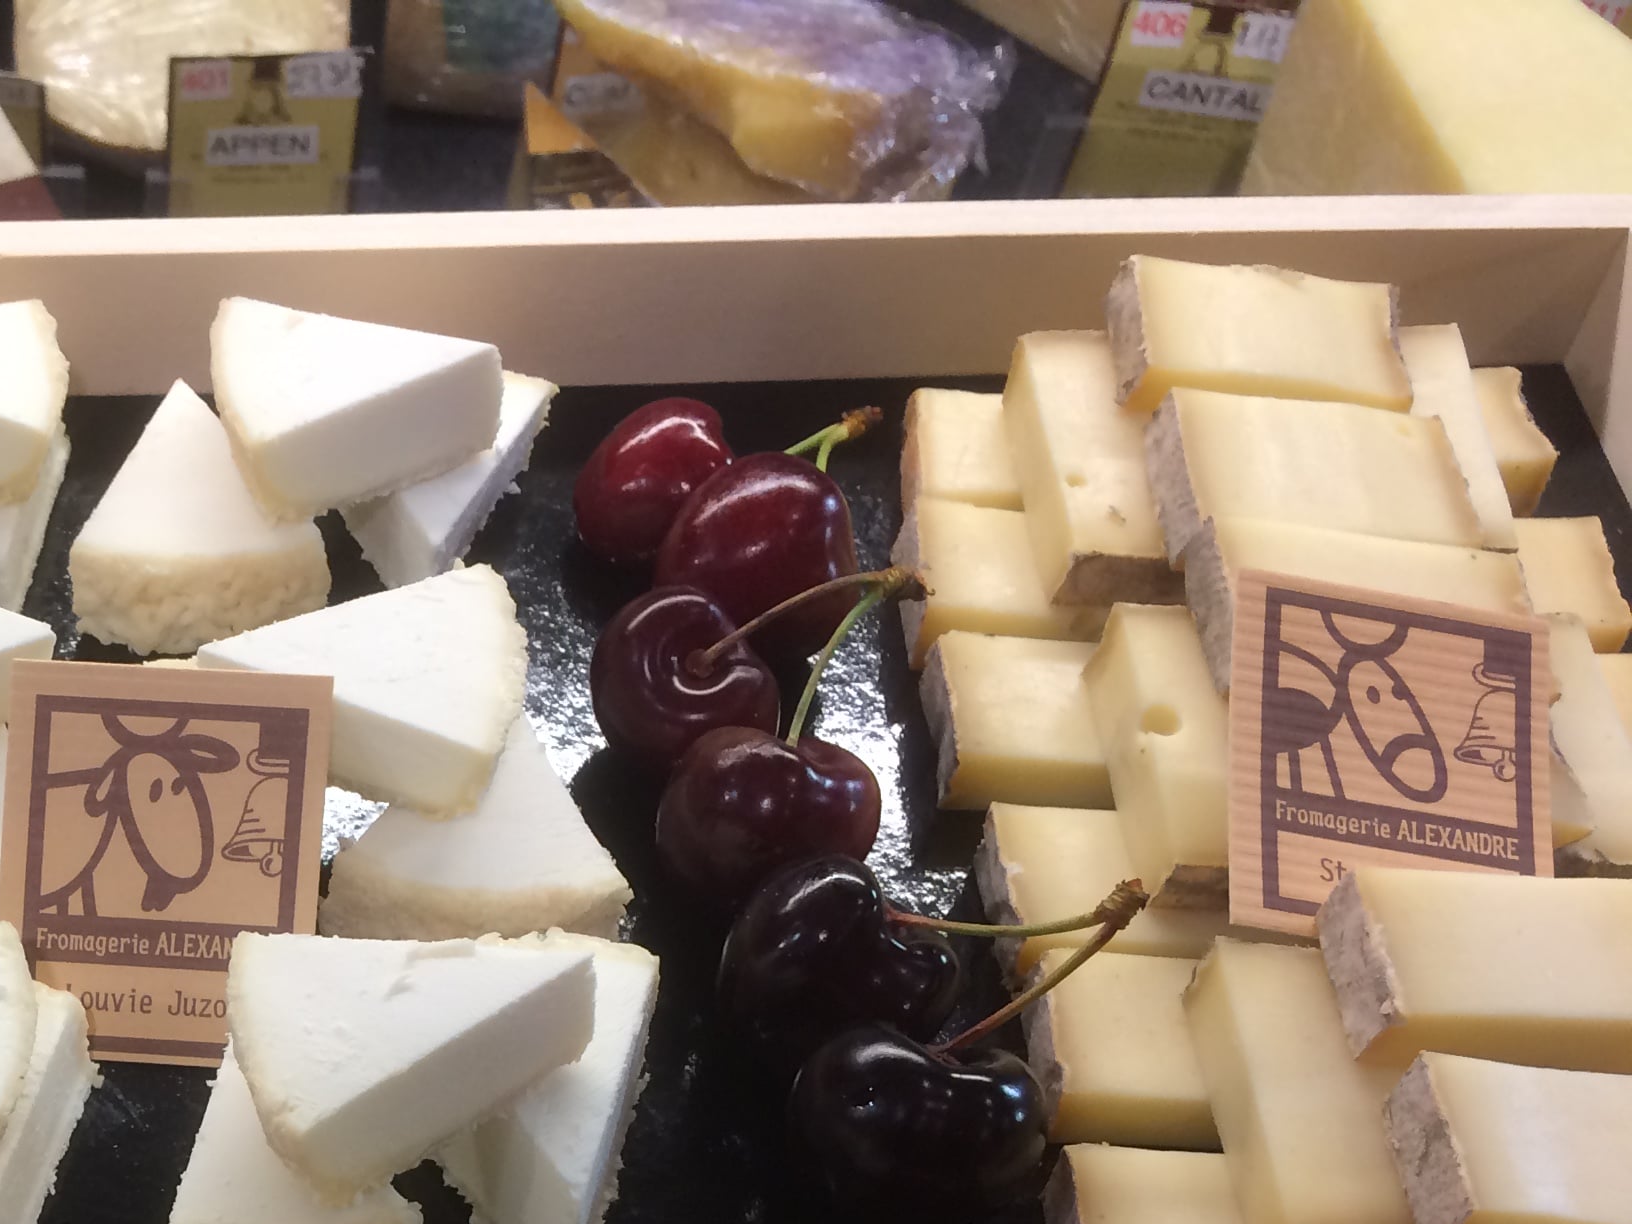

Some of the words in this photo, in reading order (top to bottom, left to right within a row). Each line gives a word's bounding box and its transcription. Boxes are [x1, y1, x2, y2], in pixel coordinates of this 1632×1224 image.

[1134, 10, 1189, 38] 406
[1146, 75, 1263, 112] CANTAL
[209, 133, 312, 155] APPEN
[1275, 799, 1391, 840] Fromagerie
[1397, 819, 1521, 861] ALEXANDRE
[36, 927, 150, 956] Fromagerie
[154, 931, 233, 960] ALEXAN
[167, 990, 228, 1019] Juzo
